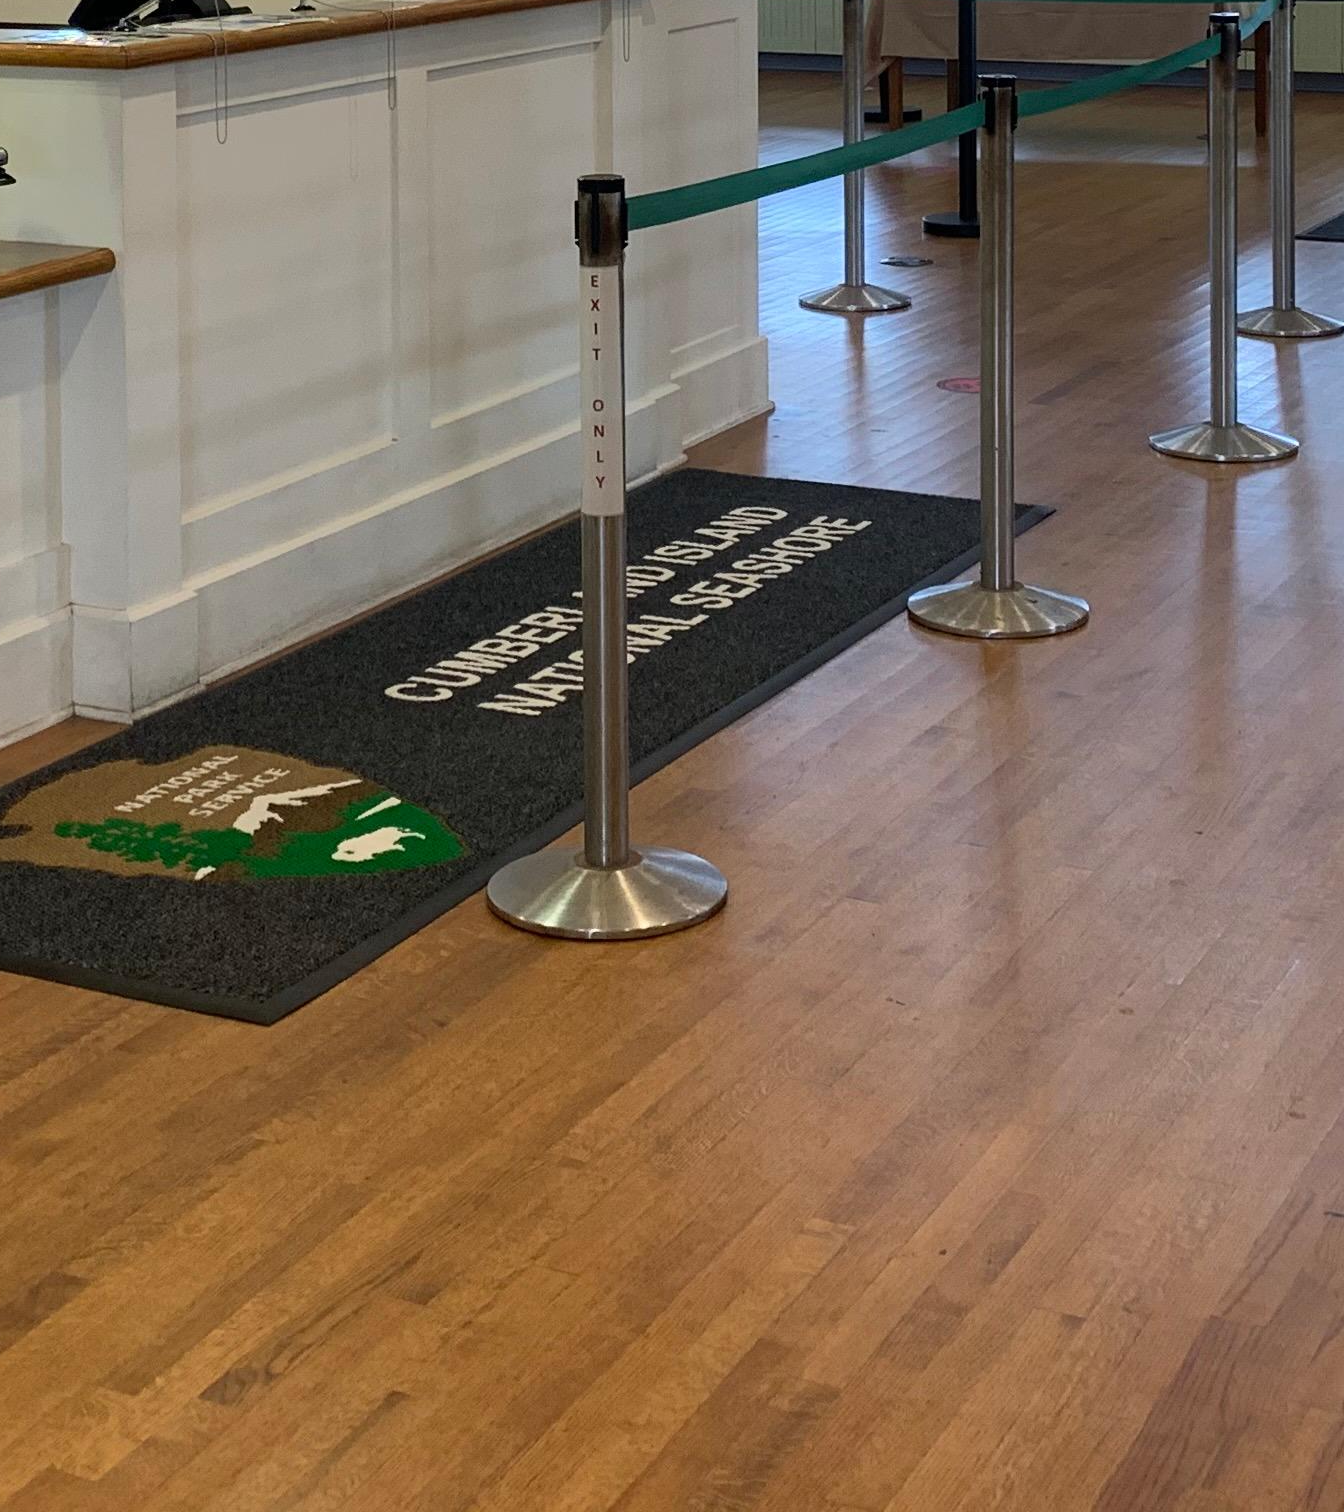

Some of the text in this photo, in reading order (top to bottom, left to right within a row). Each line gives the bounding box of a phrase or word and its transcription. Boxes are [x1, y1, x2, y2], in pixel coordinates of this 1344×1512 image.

[590, 274, 602, 362] EXIT
[592, 398, 606, 490] ONLY
[384, 505, 790, 702] CUMBERND ISLAND
[477, 514, 873, 717] NATINAL SEASHORE
[114, 754, 239, 813] NATIONAL
[173, 770, 244, 804] PARK
[188, 767, 291, 818] SERVICE
